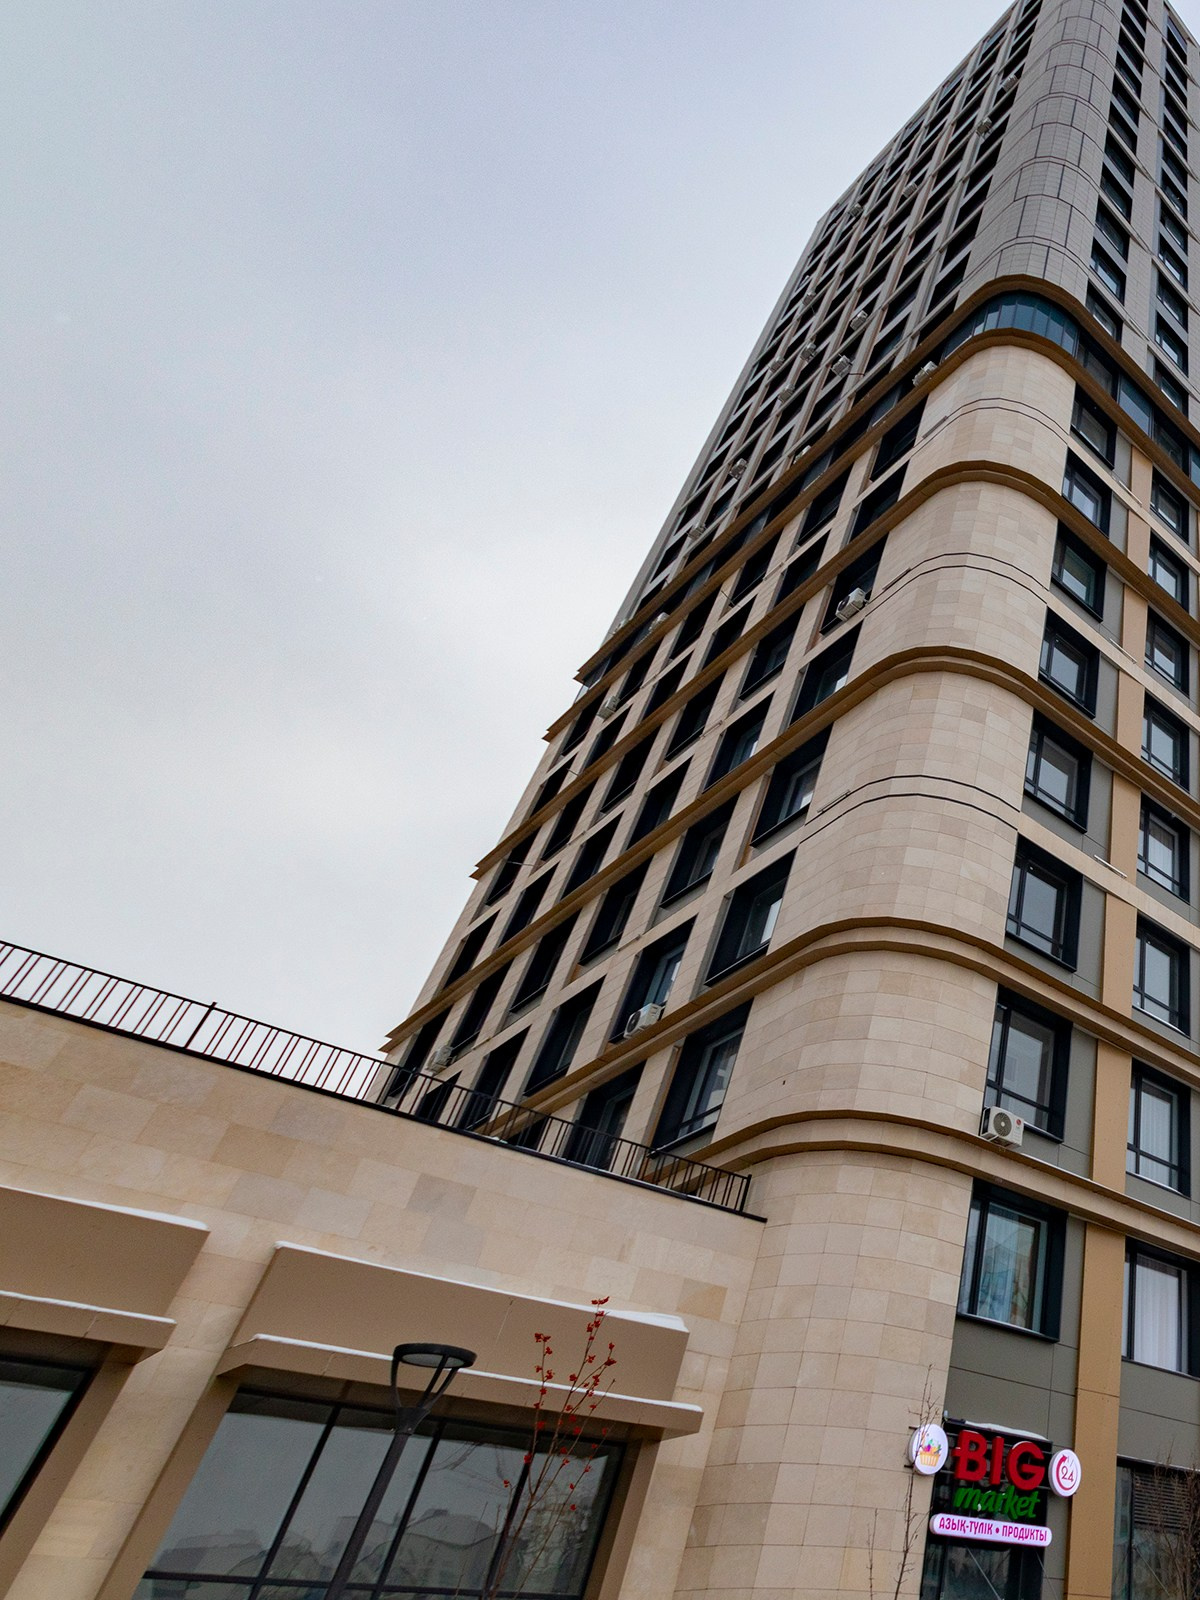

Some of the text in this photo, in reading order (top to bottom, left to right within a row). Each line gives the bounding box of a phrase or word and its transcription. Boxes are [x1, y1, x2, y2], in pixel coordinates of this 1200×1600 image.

[952, 1430, 1046, 1491] BIG
[1061, 1465, 1074, 1482] 24
[953, 1485, 1041, 1520] market
[939, 1517, 1048, 1542] АЗЫҚ-ТҮЛІК ПРОДУКТЫ
